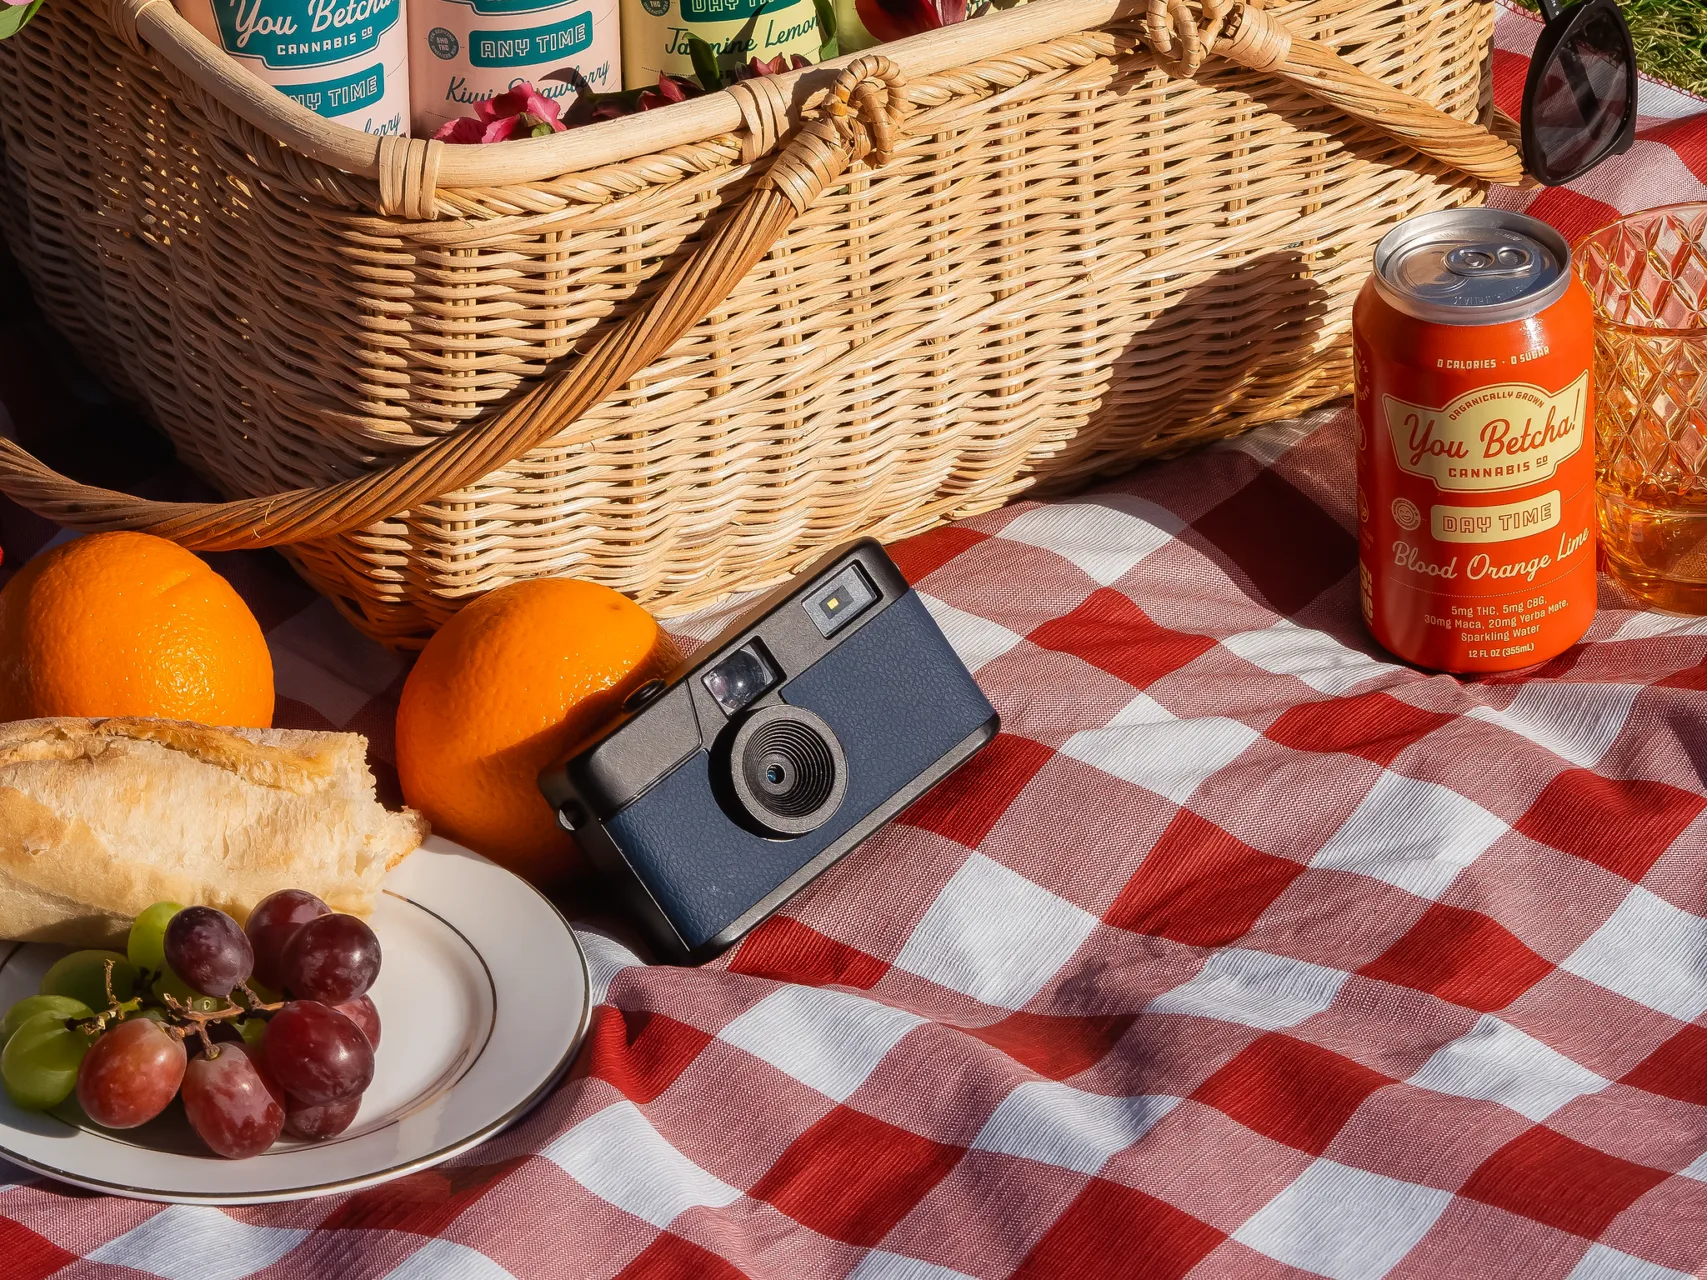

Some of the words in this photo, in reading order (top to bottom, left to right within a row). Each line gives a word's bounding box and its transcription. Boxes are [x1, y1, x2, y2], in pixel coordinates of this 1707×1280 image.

[277, 33, 356, 55] CANNABIS
[362, 26, 372, 39] CO
[480, 38, 529, 58] ANY
[536, 23, 585, 53] TIME
[665, 27, 757, 55] Jamine
[765, 15, 819, 48] Lemon
[289, 92, 321, 110] NY
[328, 75, 377, 107] TIME
[445, 75, 494, 104] Kiwi
[508, 60, 610, 98] awberry
[1446, 359, 1496, 369] CALORIES
[1520, 346, 1550, 363] SUGAR
[1449, 391, 1513, 421] ORGANICALLY
[1515, 391, 1545, 409] GROWN
[1404, 413, 1469, 466] You
[1480, 388, 1581, 459] Betcha!
[1448, 461, 1530, 478] CANNABIS
[1536, 455, 1548, 468] CO
[1442, 515, 1491, 534] DAY
[1499, 503, 1551, 531] TIME
[1392, 540, 1457, 579] Blood
[1466, 553, 1551, 582] Orange
[1557, 527, 1589, 561] Lime
[1424, 614, 1451, 629] 30mg
[1454, 619, 1485, 630] Maca,
[1488, 616, 1517, 629] 20mg
[1519, 608, 1546, 624] Yerba
[1548, 598, 1569, 615] Mate,
[1451, 606, 1473, 618] 5mg
[1476, 606, 1499, 616] THC,
[1503, 602, 1524, 614] 5mg
[1526, 595, 1547, 609] CBG,
[1461, 630, 1510, 643] Sparkling
[1513, 624, 1541, 638] Water
[1468, 650, 1477, 658] 12
[1479, 650, 1488, 658] FL
[1490, 649, 1500, 657] OZ
[1502, 642, 1534, 658] (355mL)
